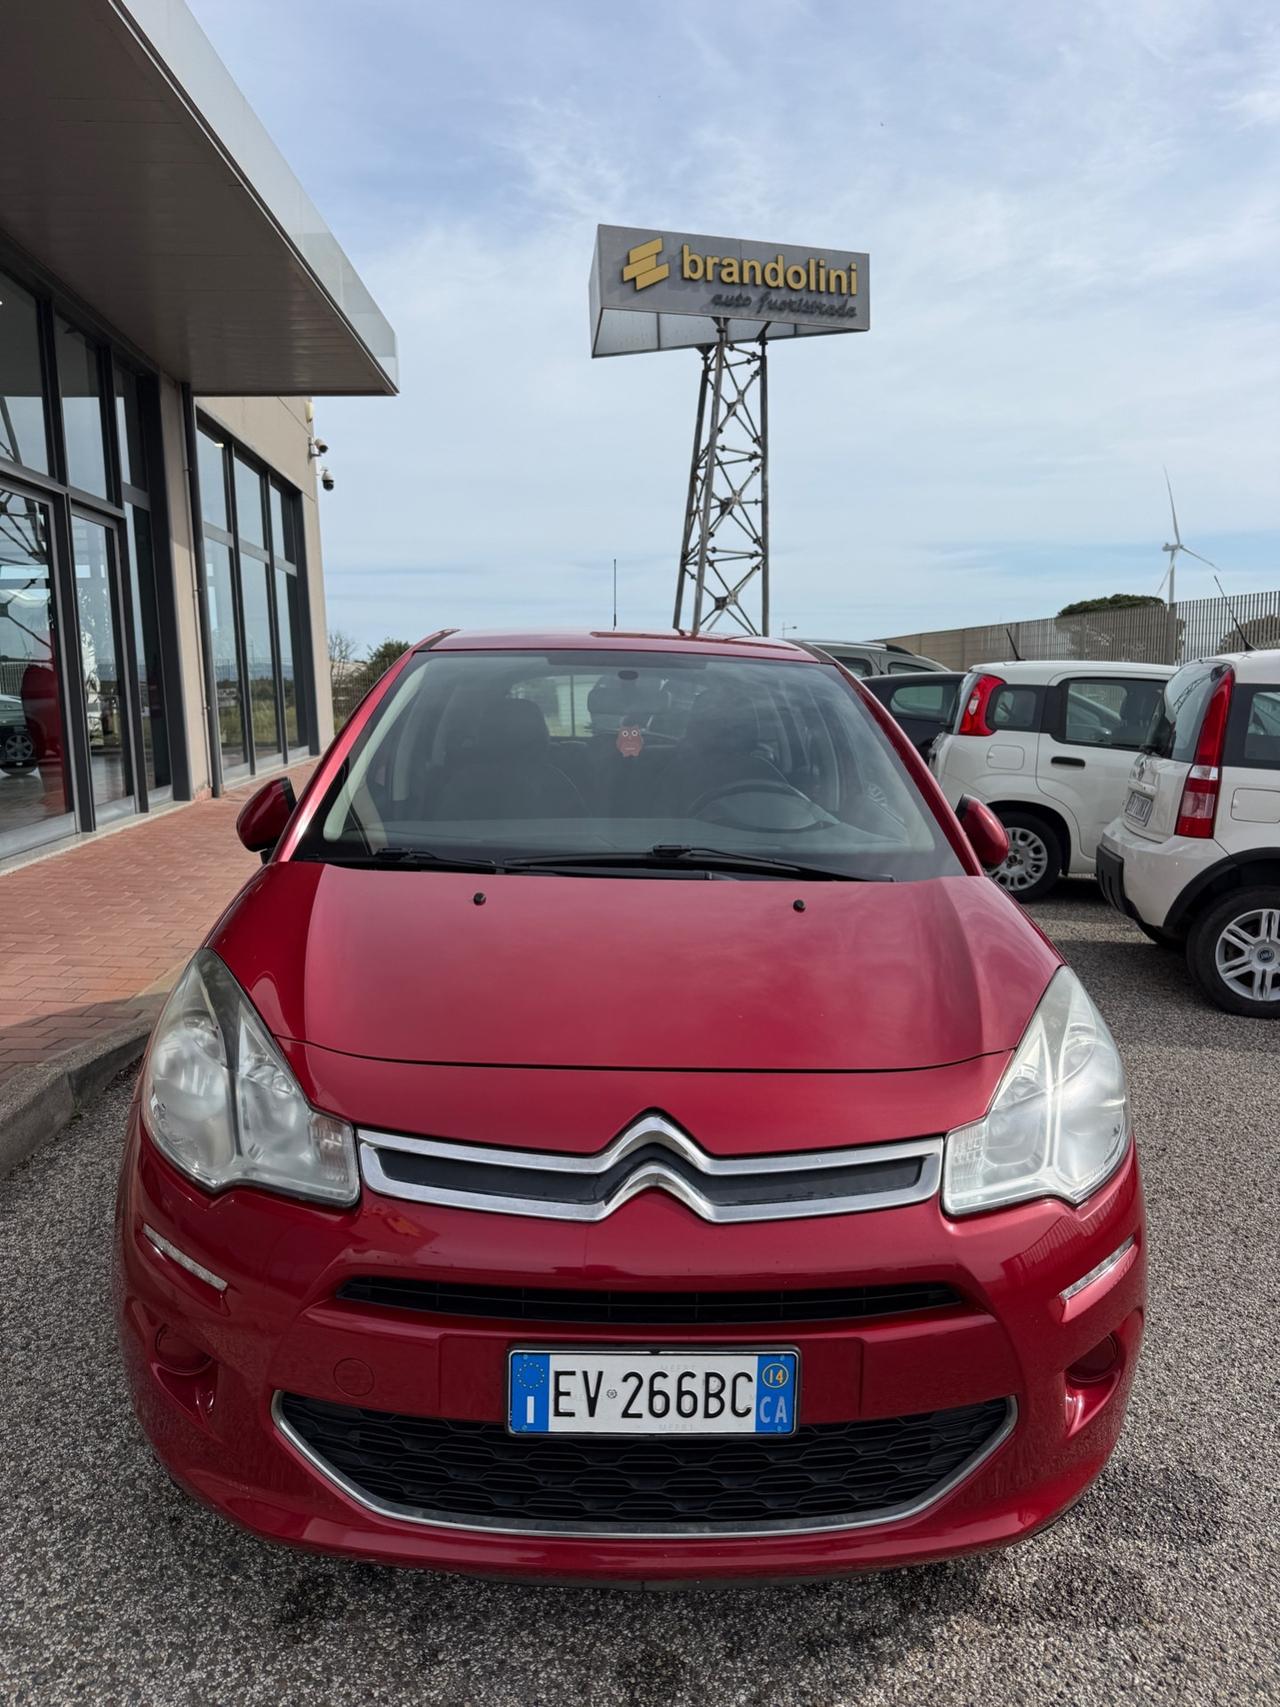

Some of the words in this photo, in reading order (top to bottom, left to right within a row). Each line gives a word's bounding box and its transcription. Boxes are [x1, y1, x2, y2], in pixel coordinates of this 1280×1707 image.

[682, 244, 857, 295] brandolini
[711, 293, 752, 307] auto
[769, 1369, 784, 1384] 14
[553, 1370, 603, 1418] EV
[621, 1371, 753, 1419] 266BC
[759, 1396, 788, 1423] CA
